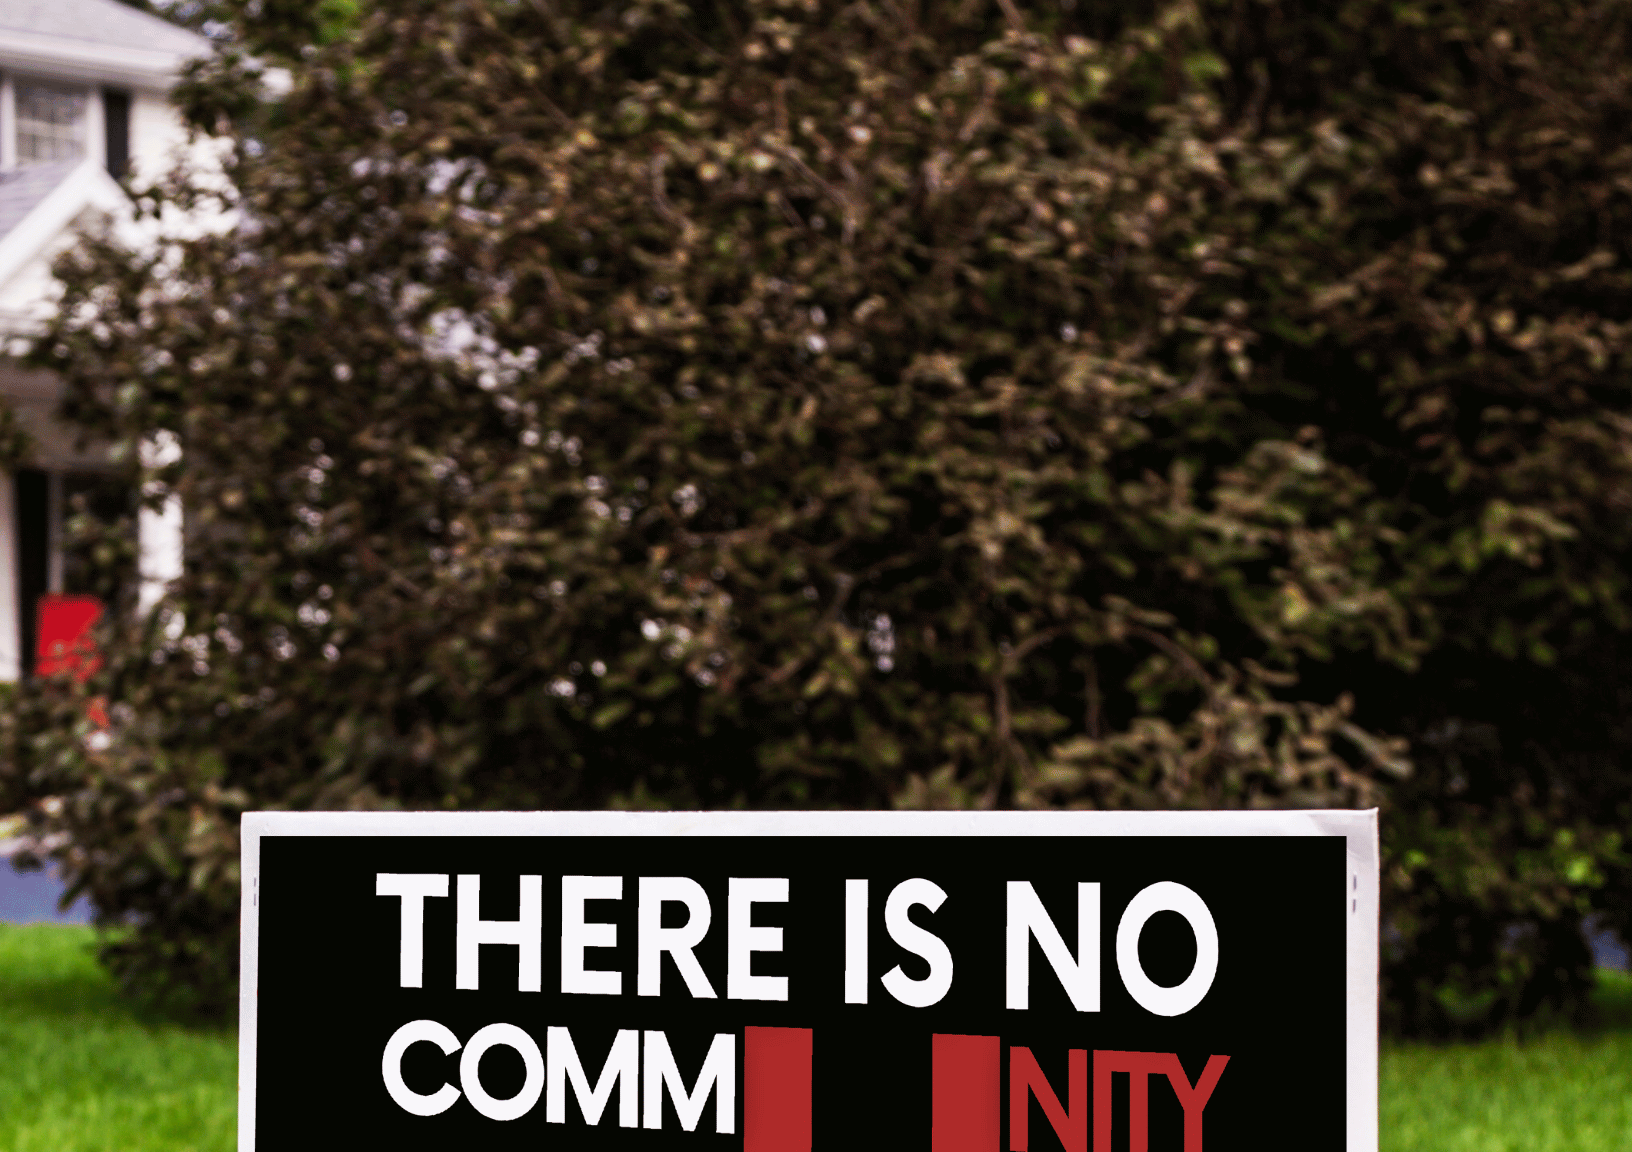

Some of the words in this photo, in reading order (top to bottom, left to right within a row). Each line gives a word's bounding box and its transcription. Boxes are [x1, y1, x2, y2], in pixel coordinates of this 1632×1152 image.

[375, 872, 790, 1001] THERE
[844, 877, 954, 1008] IS
[1006, 880, 1219, 1017] NO
